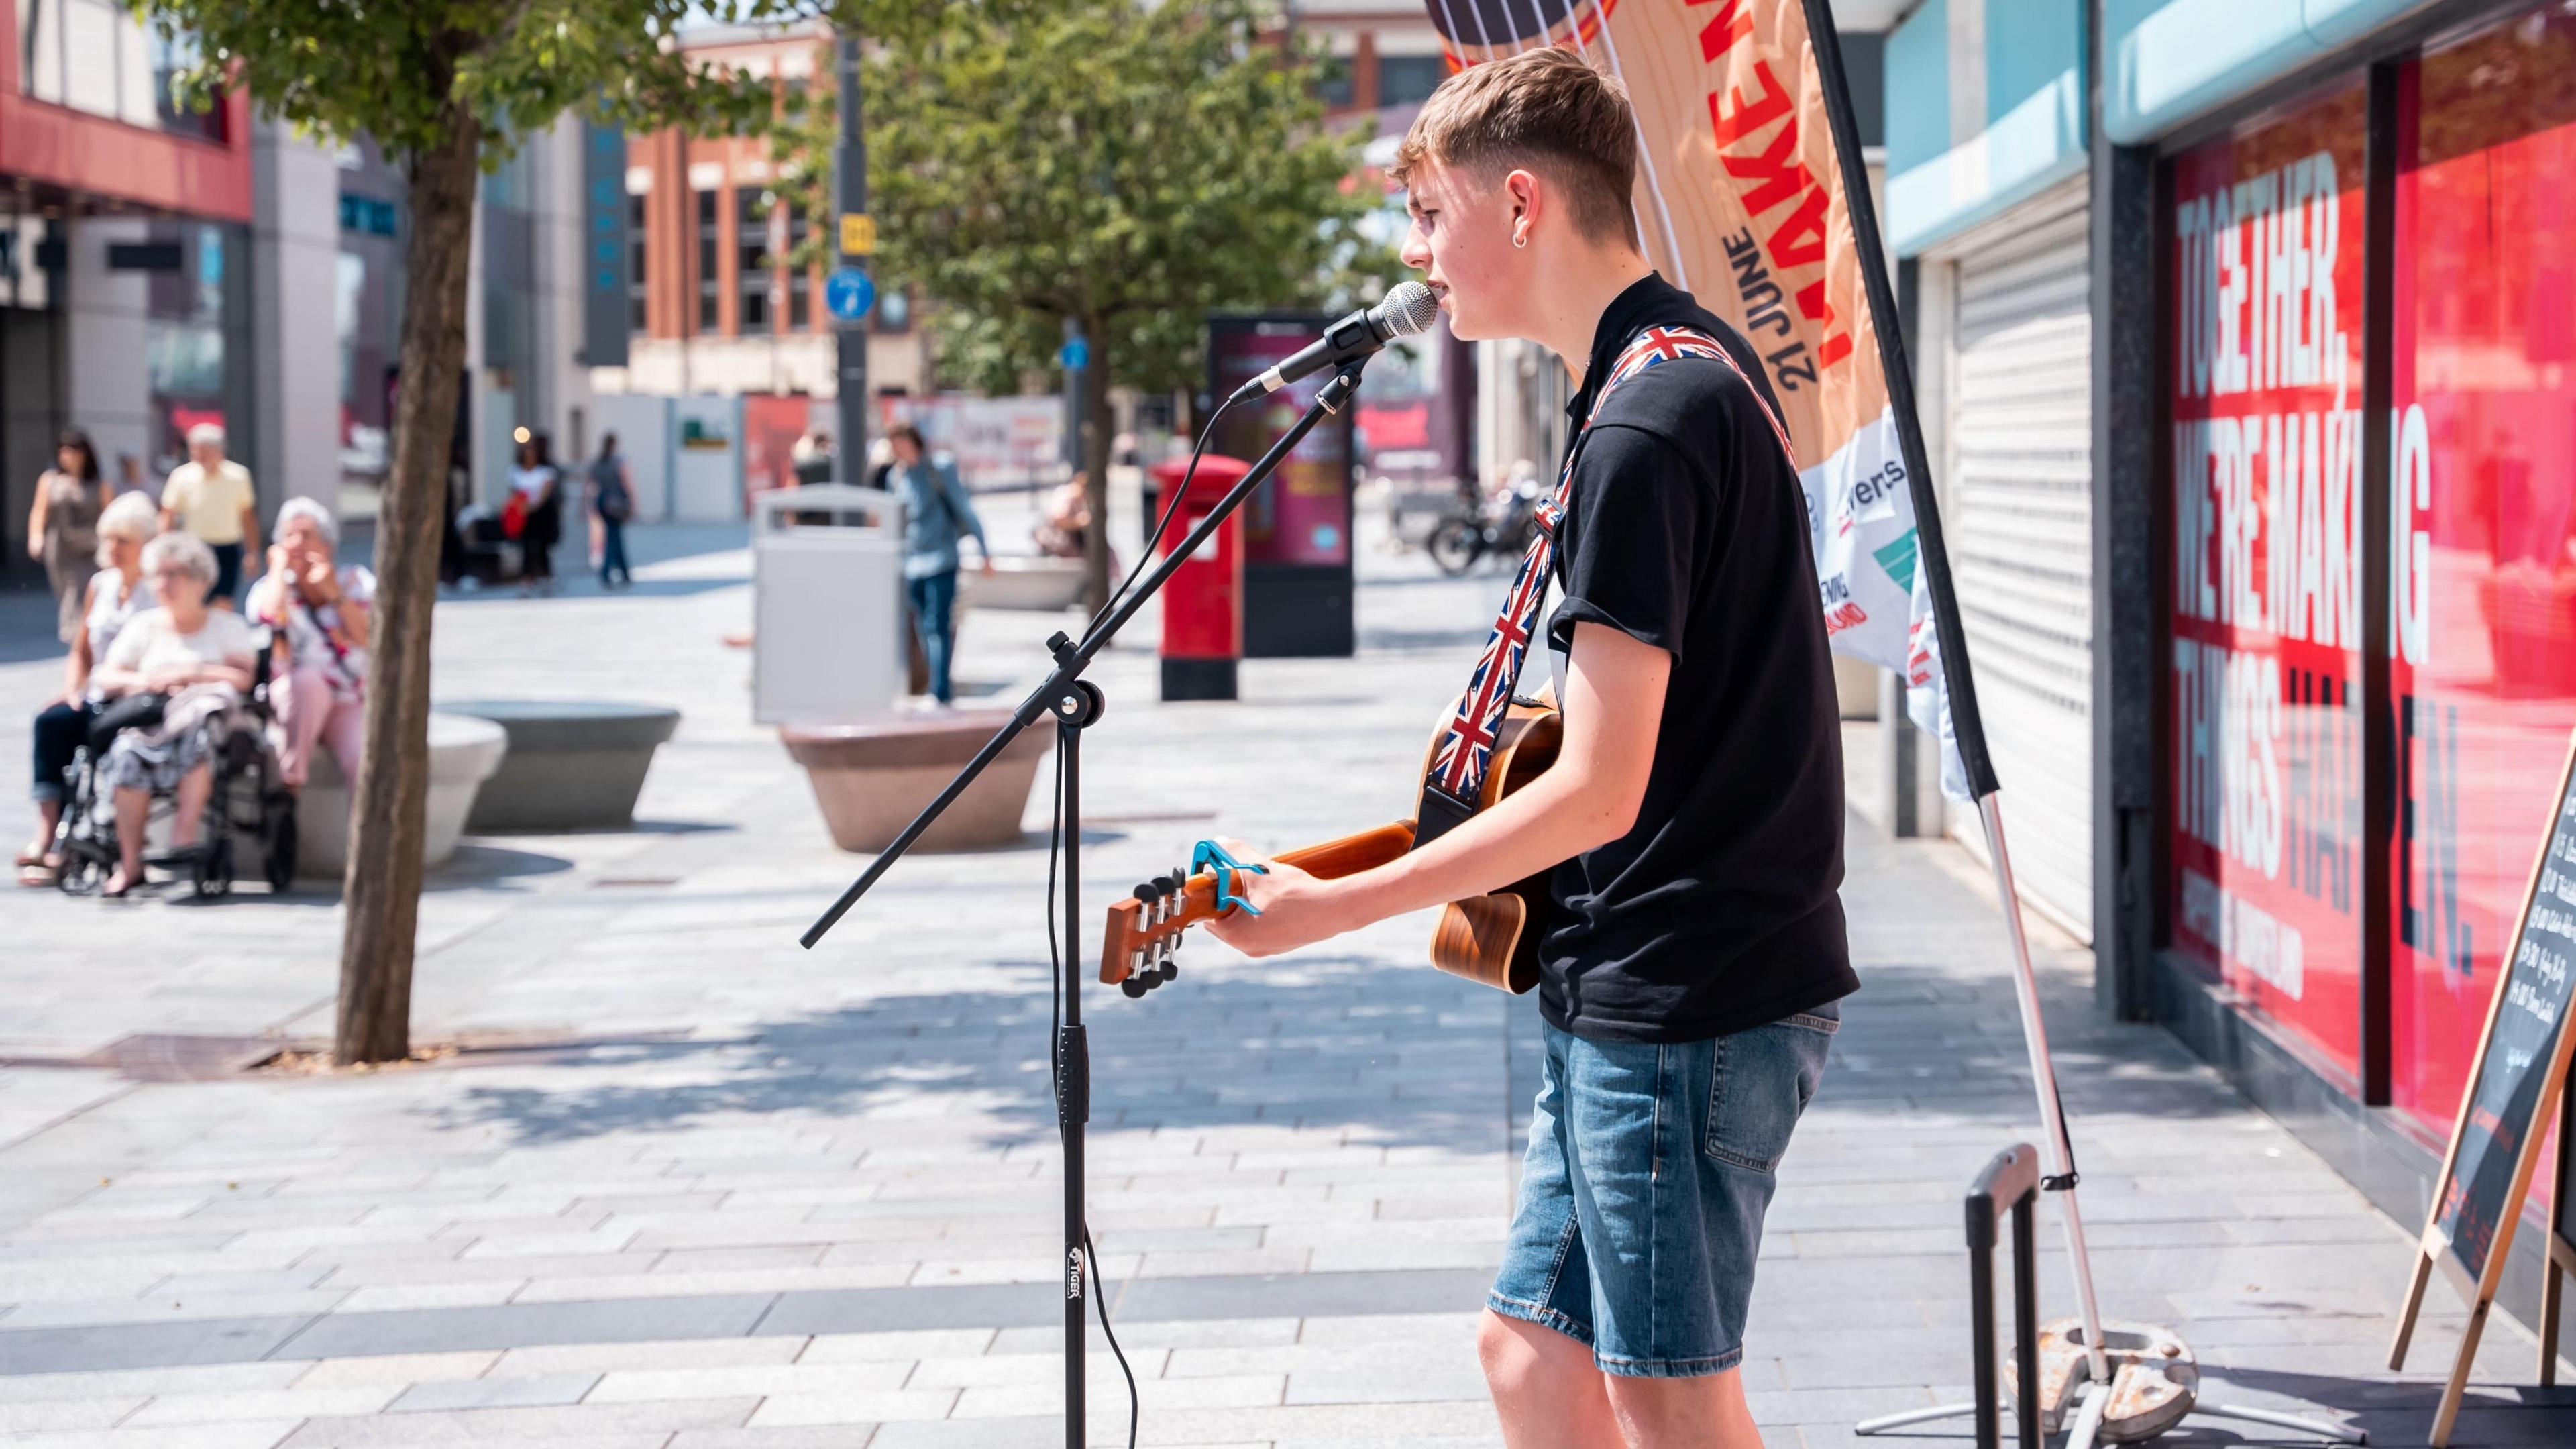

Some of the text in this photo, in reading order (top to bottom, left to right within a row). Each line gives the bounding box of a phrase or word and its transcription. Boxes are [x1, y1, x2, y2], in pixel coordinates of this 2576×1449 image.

[1722, 225, 1818, 392] 21 JUNE
[2175, 637, 2281, 880] THINGS
[1067, 1265, 1081, 1299] TIGER
